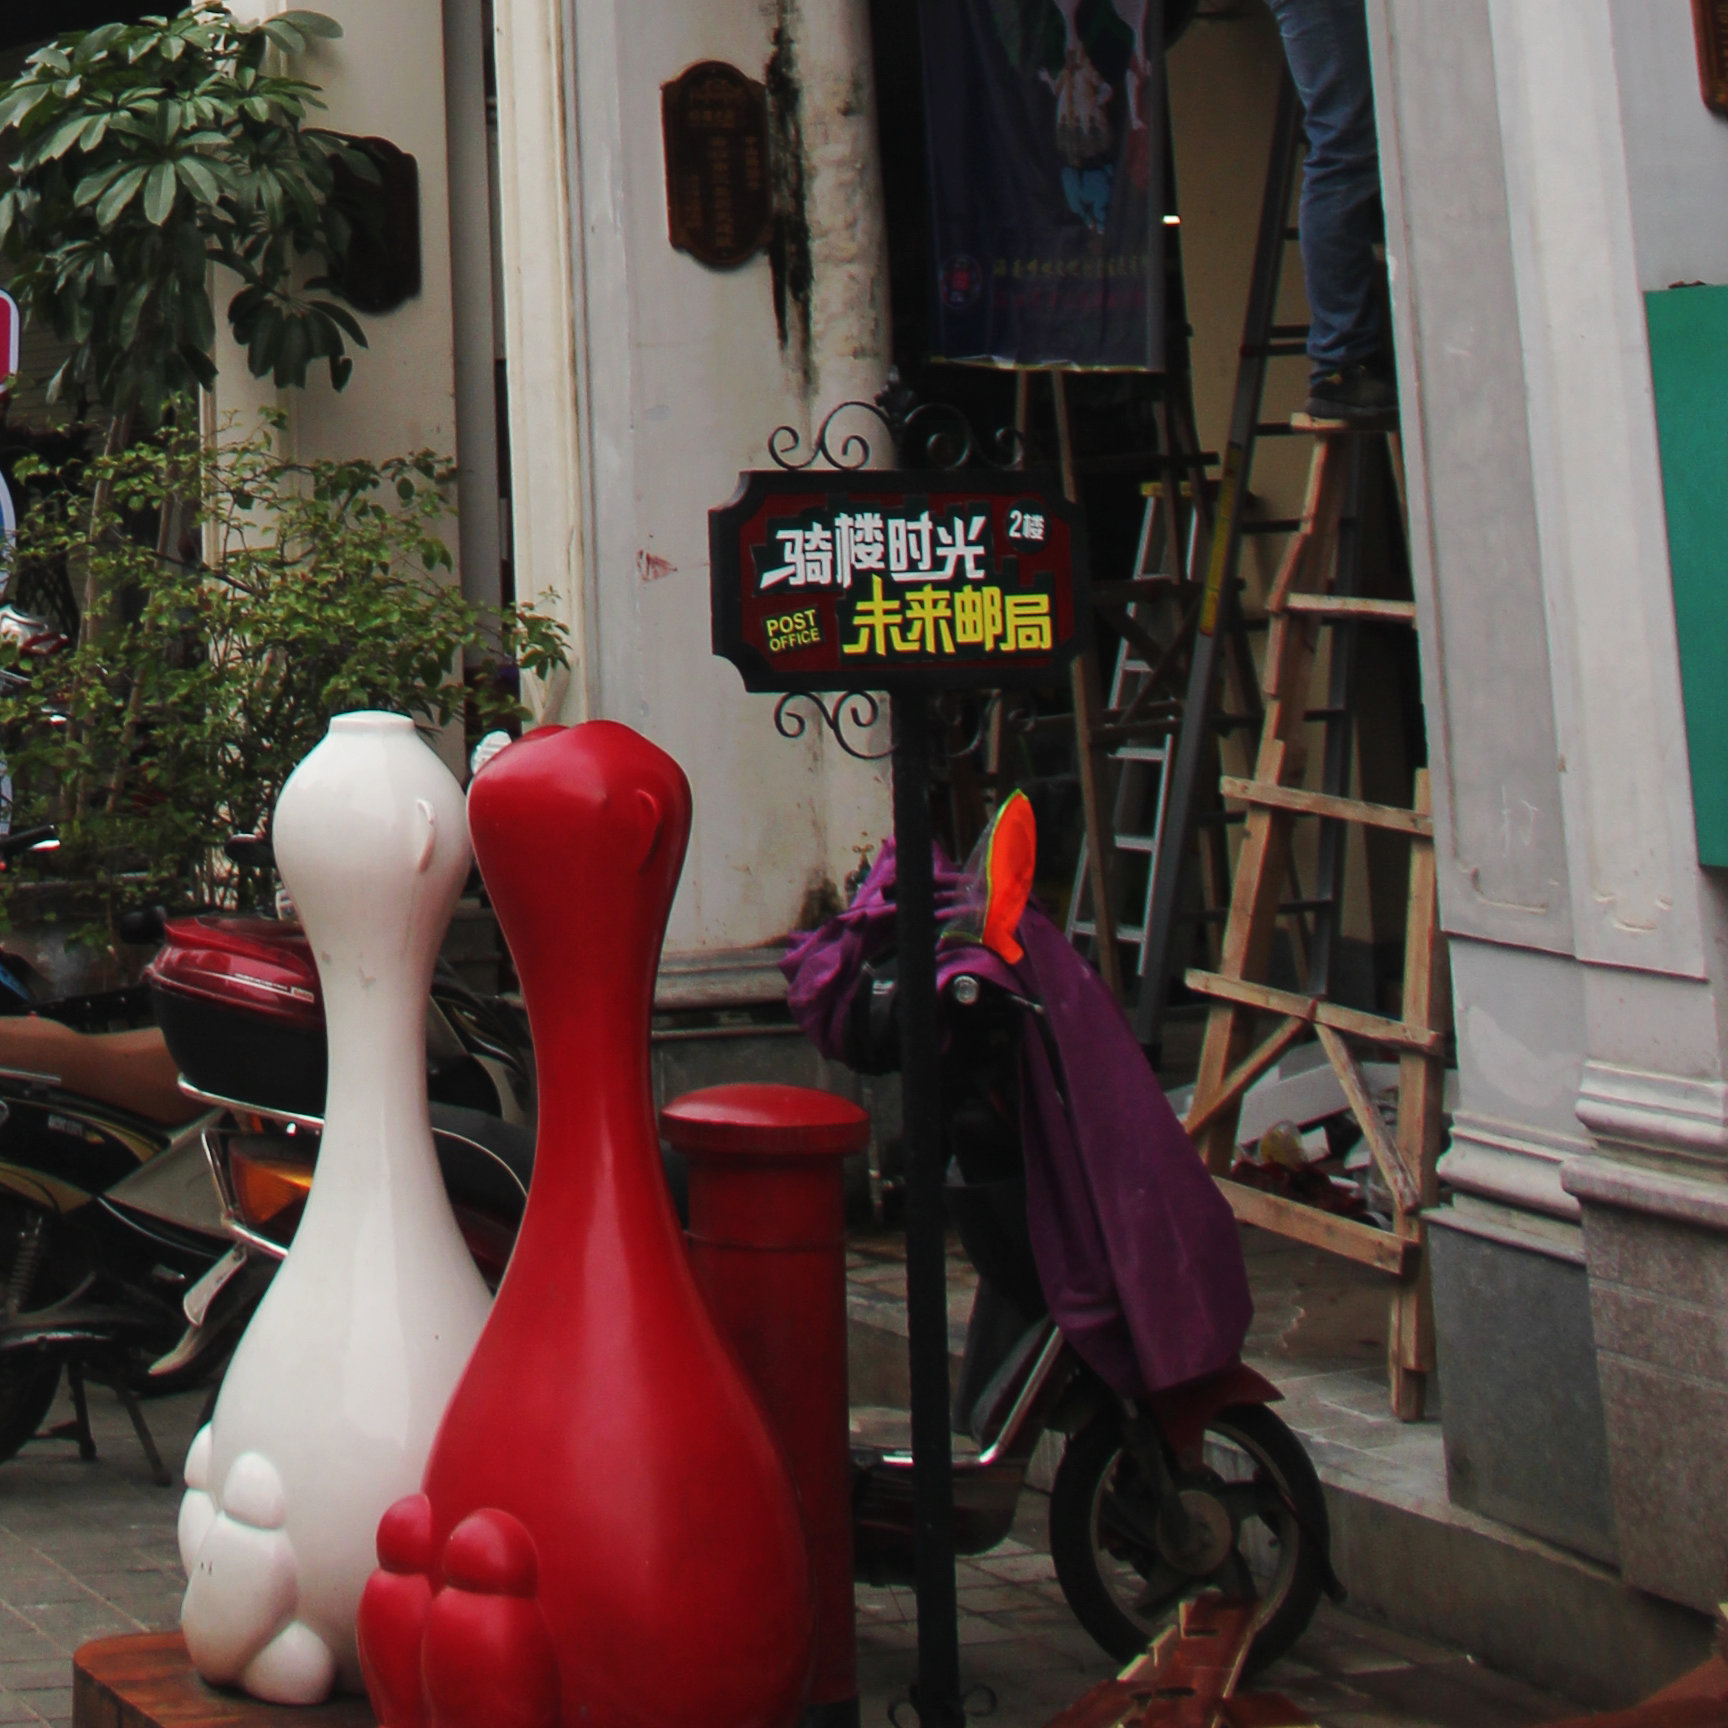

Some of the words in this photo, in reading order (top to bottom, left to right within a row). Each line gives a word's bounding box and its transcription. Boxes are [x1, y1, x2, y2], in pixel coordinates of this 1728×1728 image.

[1009, 509, 1046, 541] 2楼
[759, 510, 986, 590] 骑楼时光
[767, 609, 818, 637] POST
[842, 574, 1053, 656] 未来邮局
[769, 627, 821, 652] OFFICE
